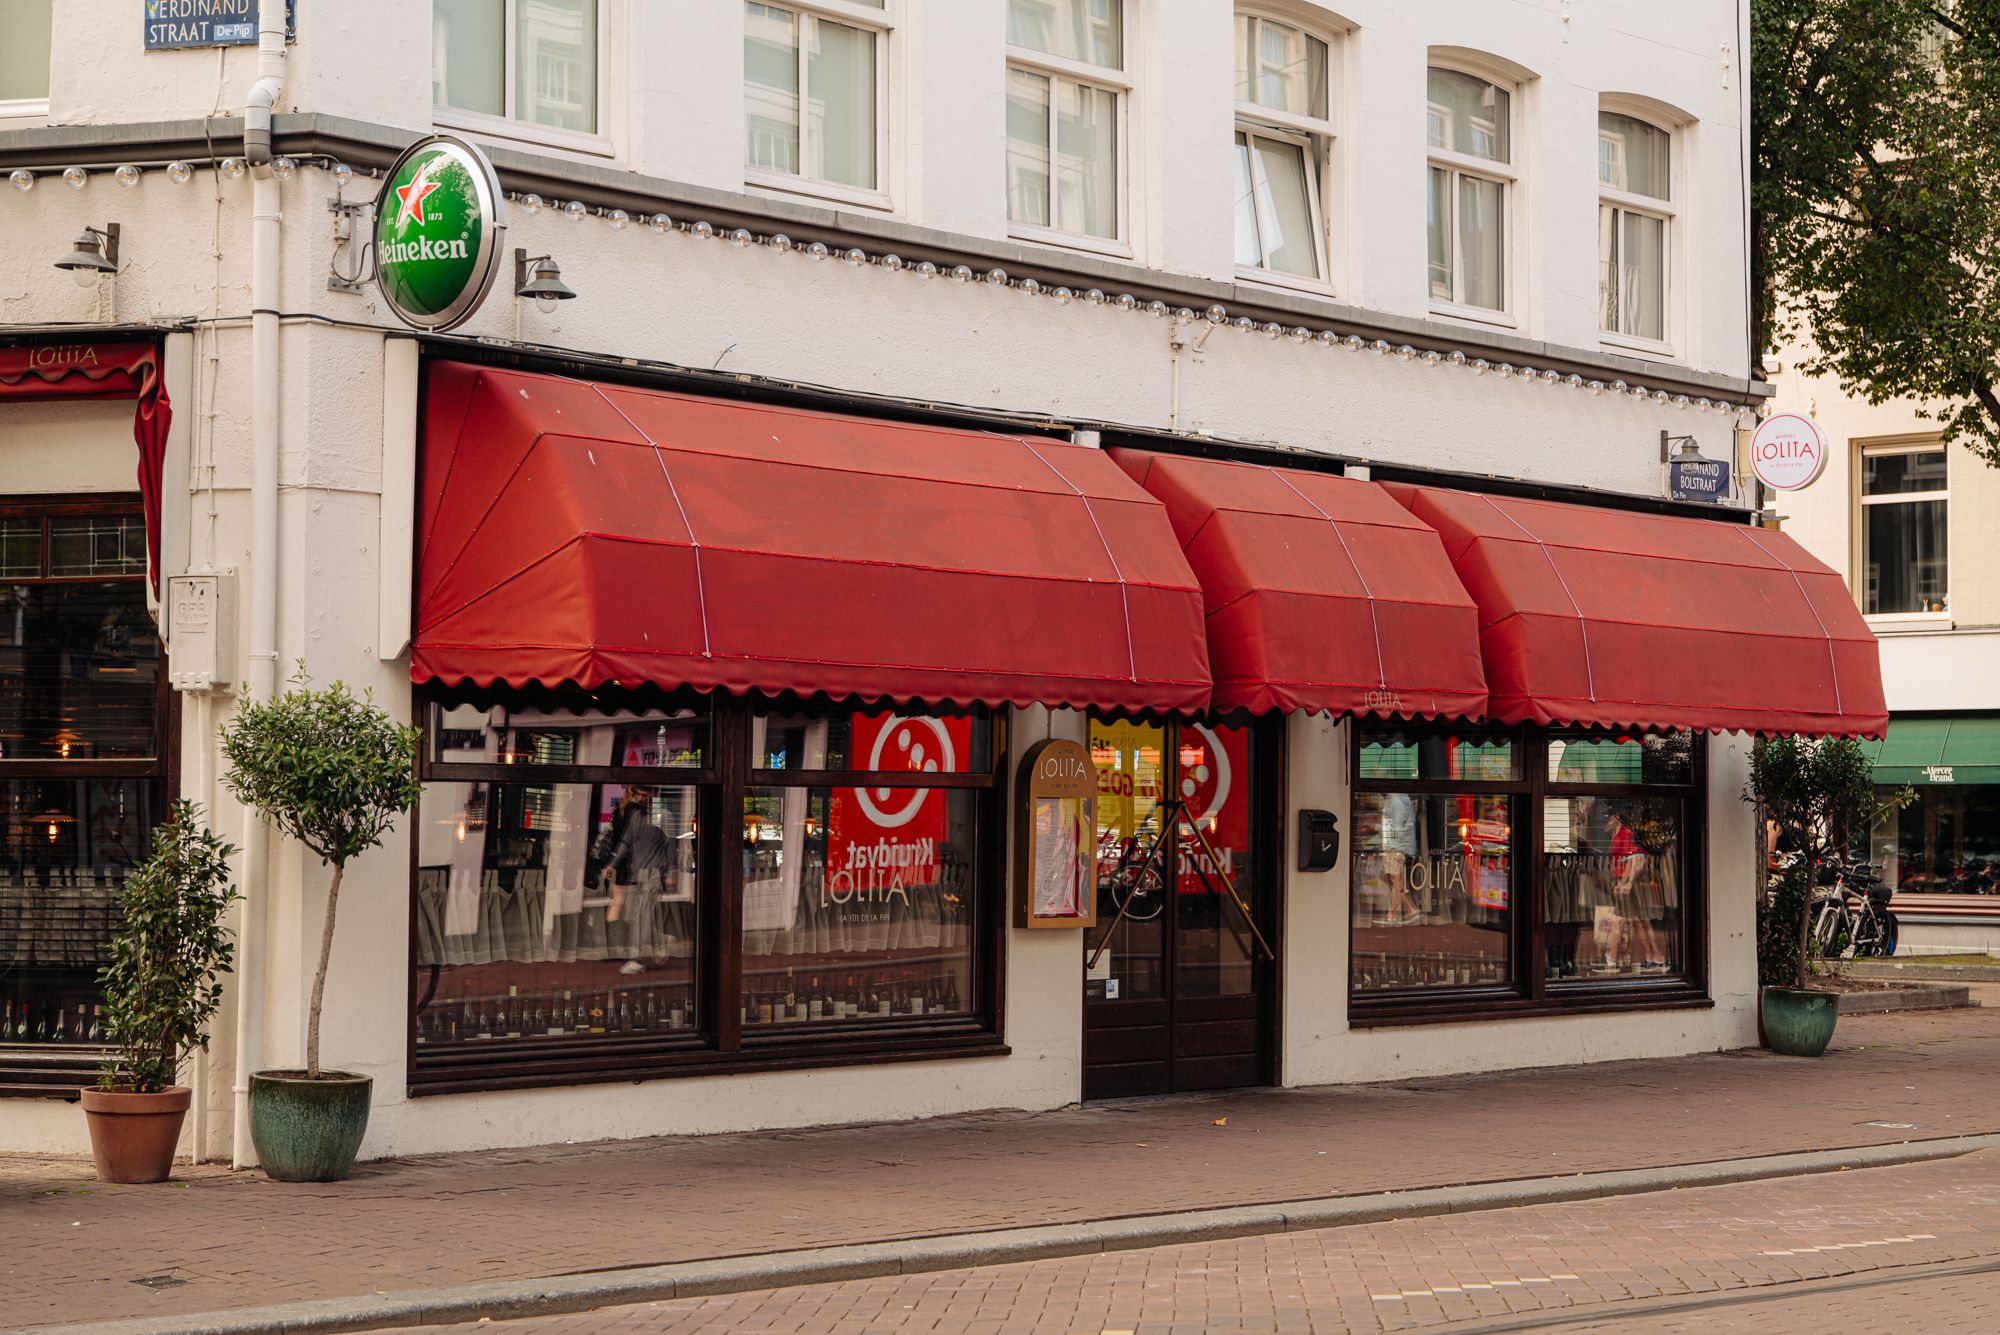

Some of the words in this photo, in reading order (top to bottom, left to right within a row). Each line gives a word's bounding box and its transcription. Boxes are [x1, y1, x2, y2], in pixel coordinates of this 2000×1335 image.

[150, 22, 209, 43] STRAAT
[428, 212, 443, 221] 1873
[379, 235, 468, 265] Heineken
[30, 345, 98, 368] LOLITA
[1756, 441, 1815, 462] LOLITA
[1680, 475, 1717, 492] BOLSTRAAT
[1364, 690, 1404, 710] LOLITA
[1040, 757, 1088, 780] LOLITA
[1927, 766, 1952, 774] Mercer
[1403, 861, 1466, 894] LOLITA
[820, 868, 909, 909] LOLITA
